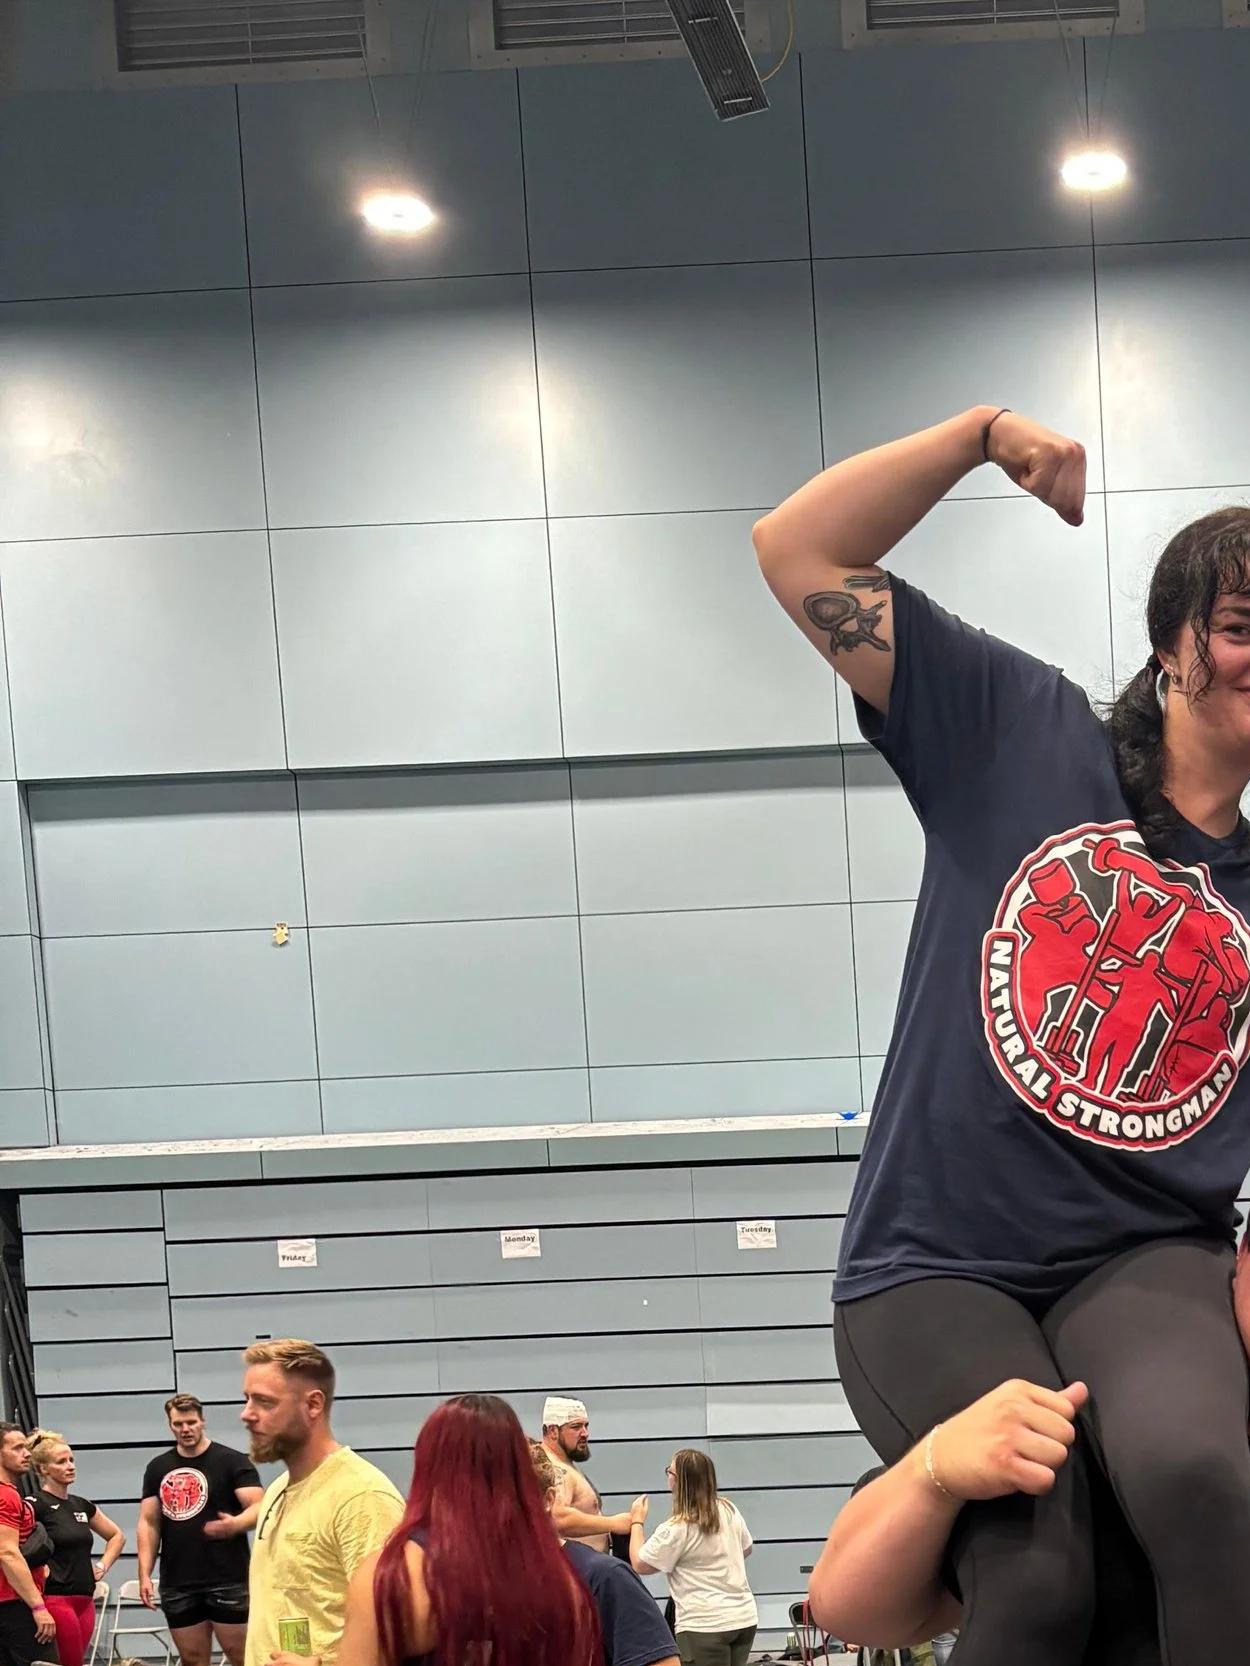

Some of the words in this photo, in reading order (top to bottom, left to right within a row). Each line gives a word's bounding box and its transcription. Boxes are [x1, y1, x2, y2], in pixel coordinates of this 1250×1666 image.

[988, 939, 1053, 1099] NATURAL
[1056, 1058, 1233, 1139] STRONGMAN
[504, 1235, 536, 1243] Monday
[281, 1254, 307, 1262] Friday
